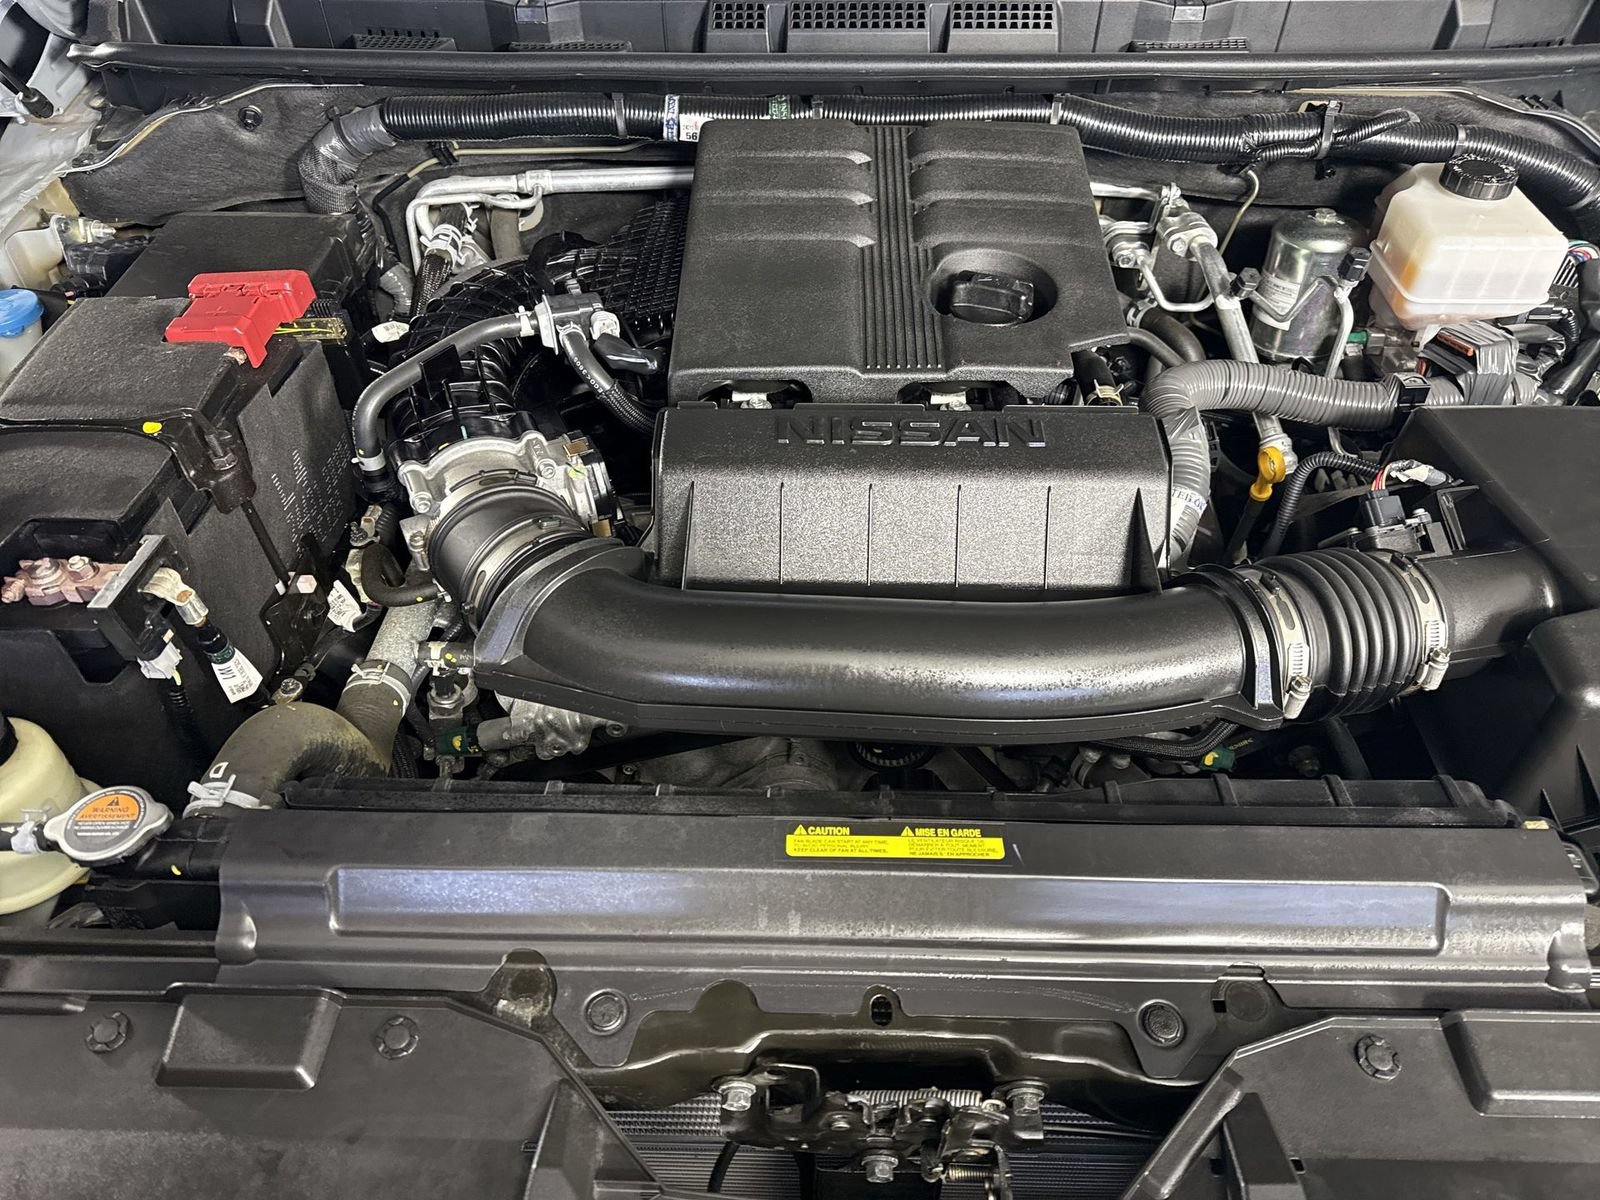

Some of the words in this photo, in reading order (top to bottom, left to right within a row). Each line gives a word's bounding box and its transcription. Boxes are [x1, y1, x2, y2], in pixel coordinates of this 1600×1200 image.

[685, 131, 698, 141] 56
[776, 416, 1046, 448] NISSAN
[807, 826, 850, 835] CAUTION
[914, 827, 937, 837] MISE
[937, 828, 950, 837] EN
[950, 828, 982, 838] GARDE
